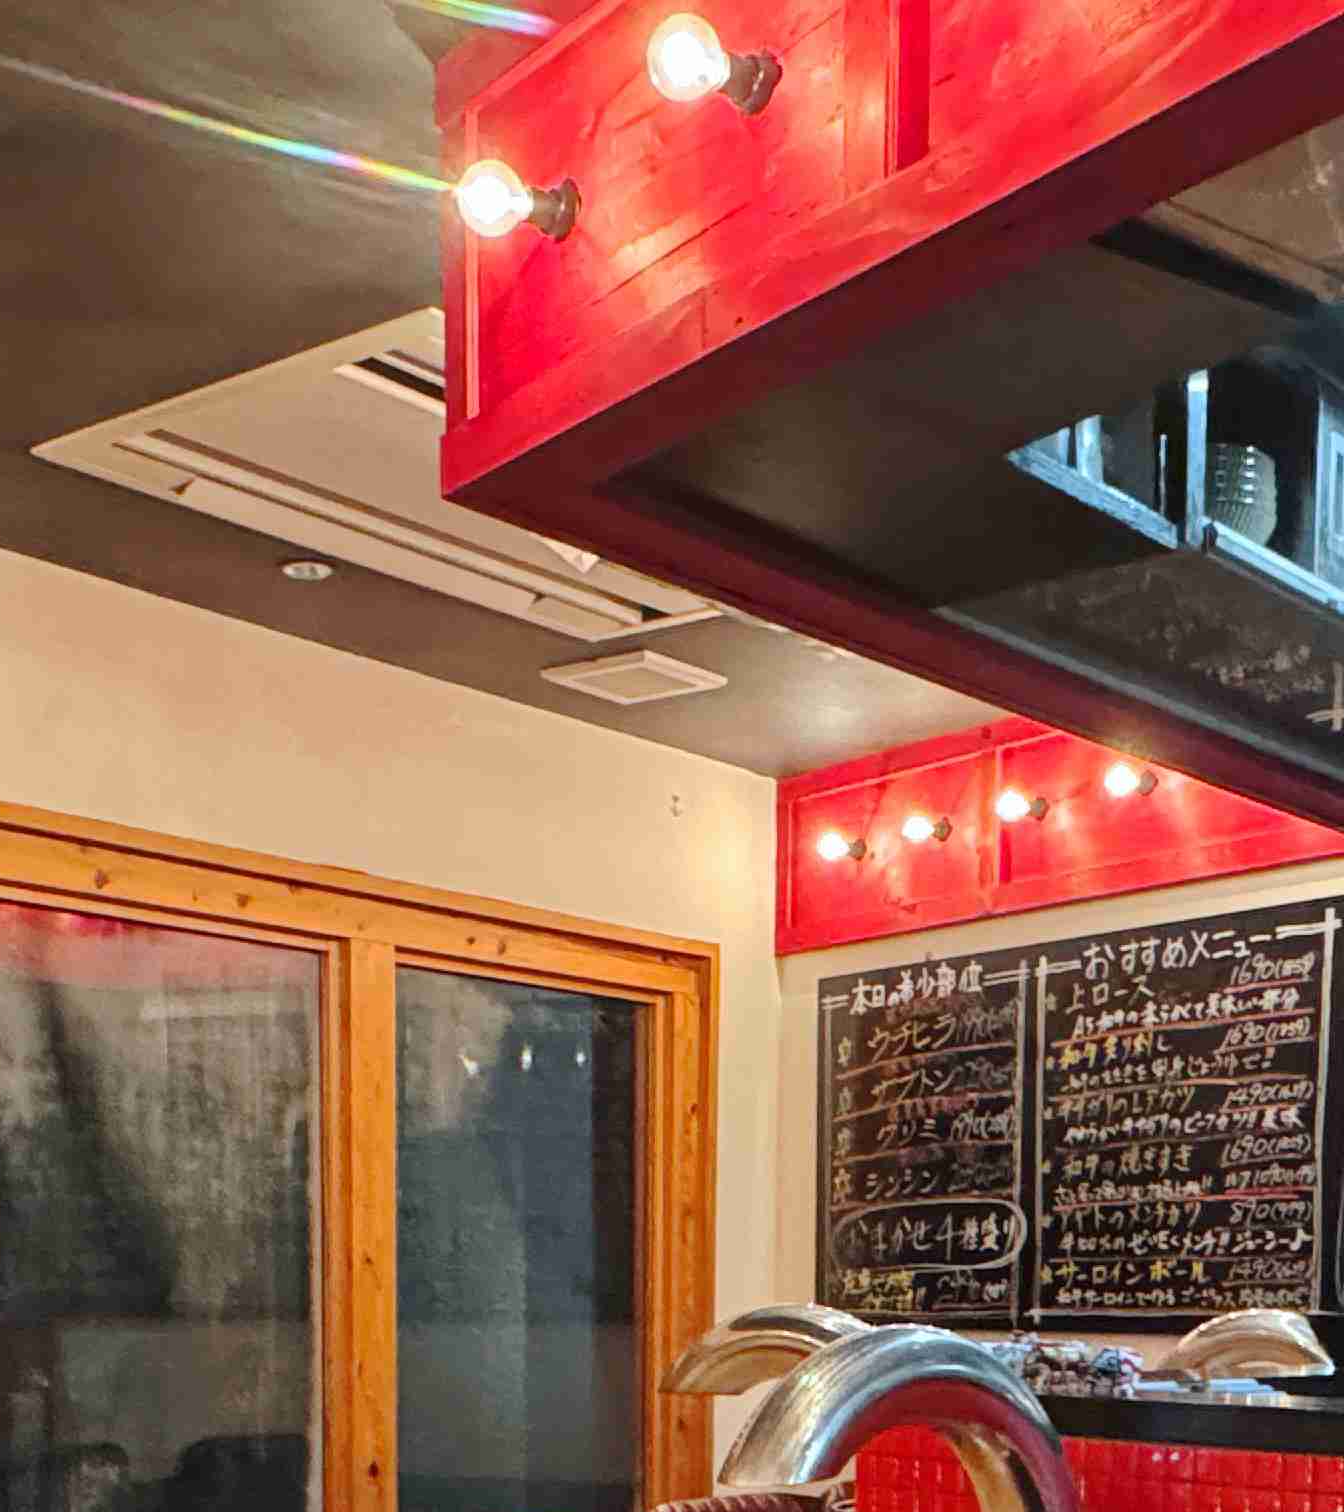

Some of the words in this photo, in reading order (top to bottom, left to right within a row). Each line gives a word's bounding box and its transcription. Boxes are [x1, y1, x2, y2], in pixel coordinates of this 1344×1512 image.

[1082, 928, 1273, 981] おすすめメニュー
[849, 959, 984, 1016] 本日の希少部位
